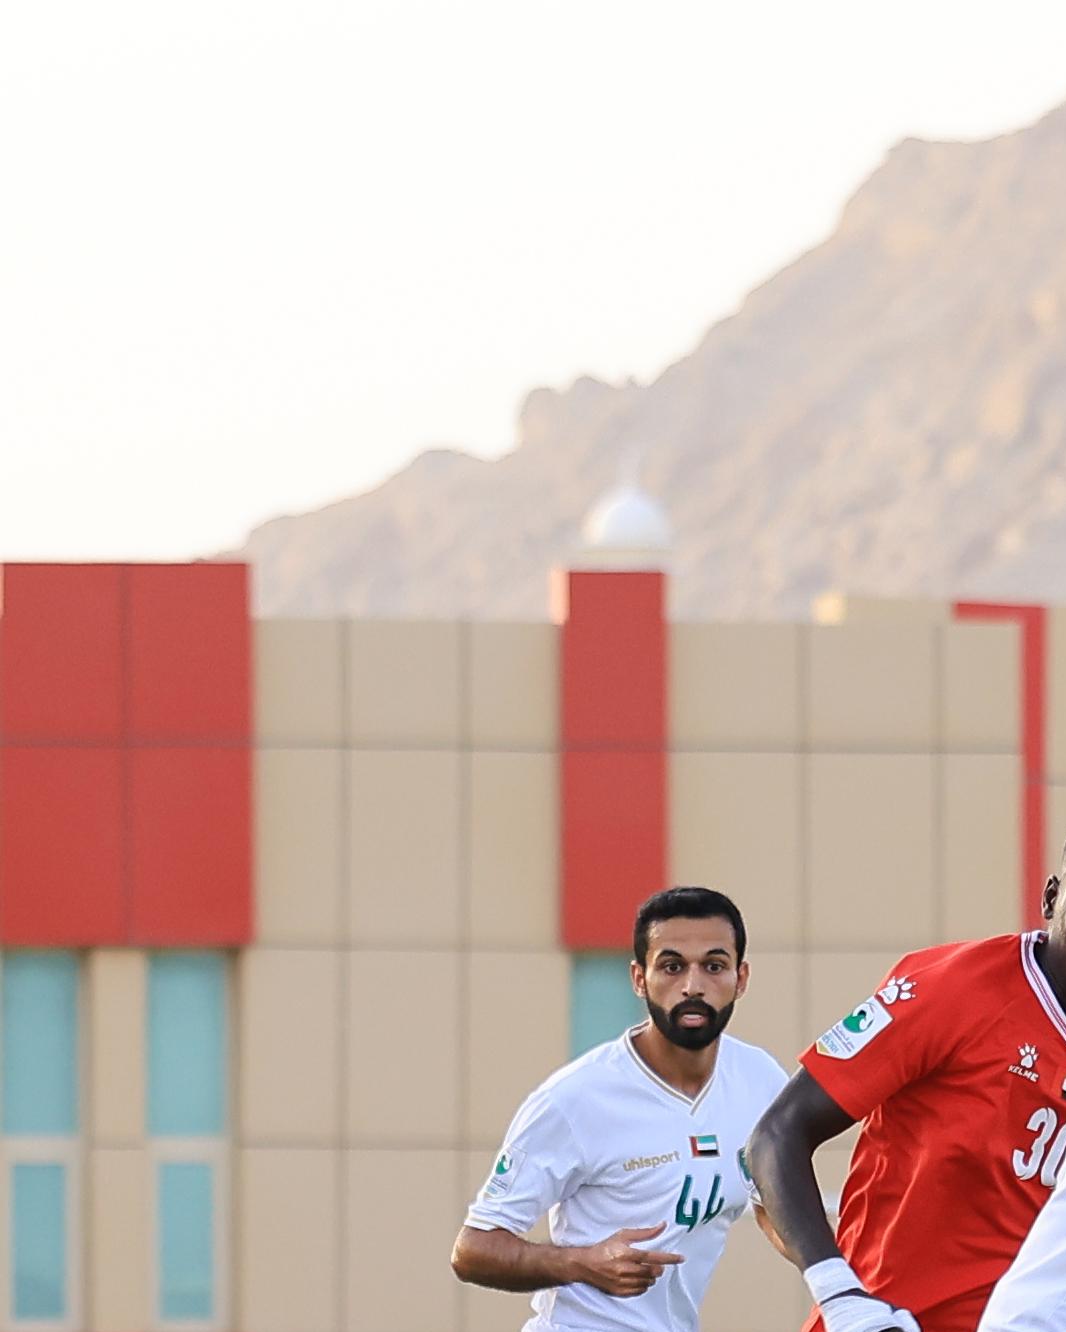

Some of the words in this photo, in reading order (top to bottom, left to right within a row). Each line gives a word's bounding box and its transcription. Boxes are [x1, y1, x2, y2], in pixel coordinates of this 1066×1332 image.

[1008, 1064, 1040, 1083] KELME
[622, 1150, 681, 1172] uhlsport
[674, 1173, 725, 1234] 44
